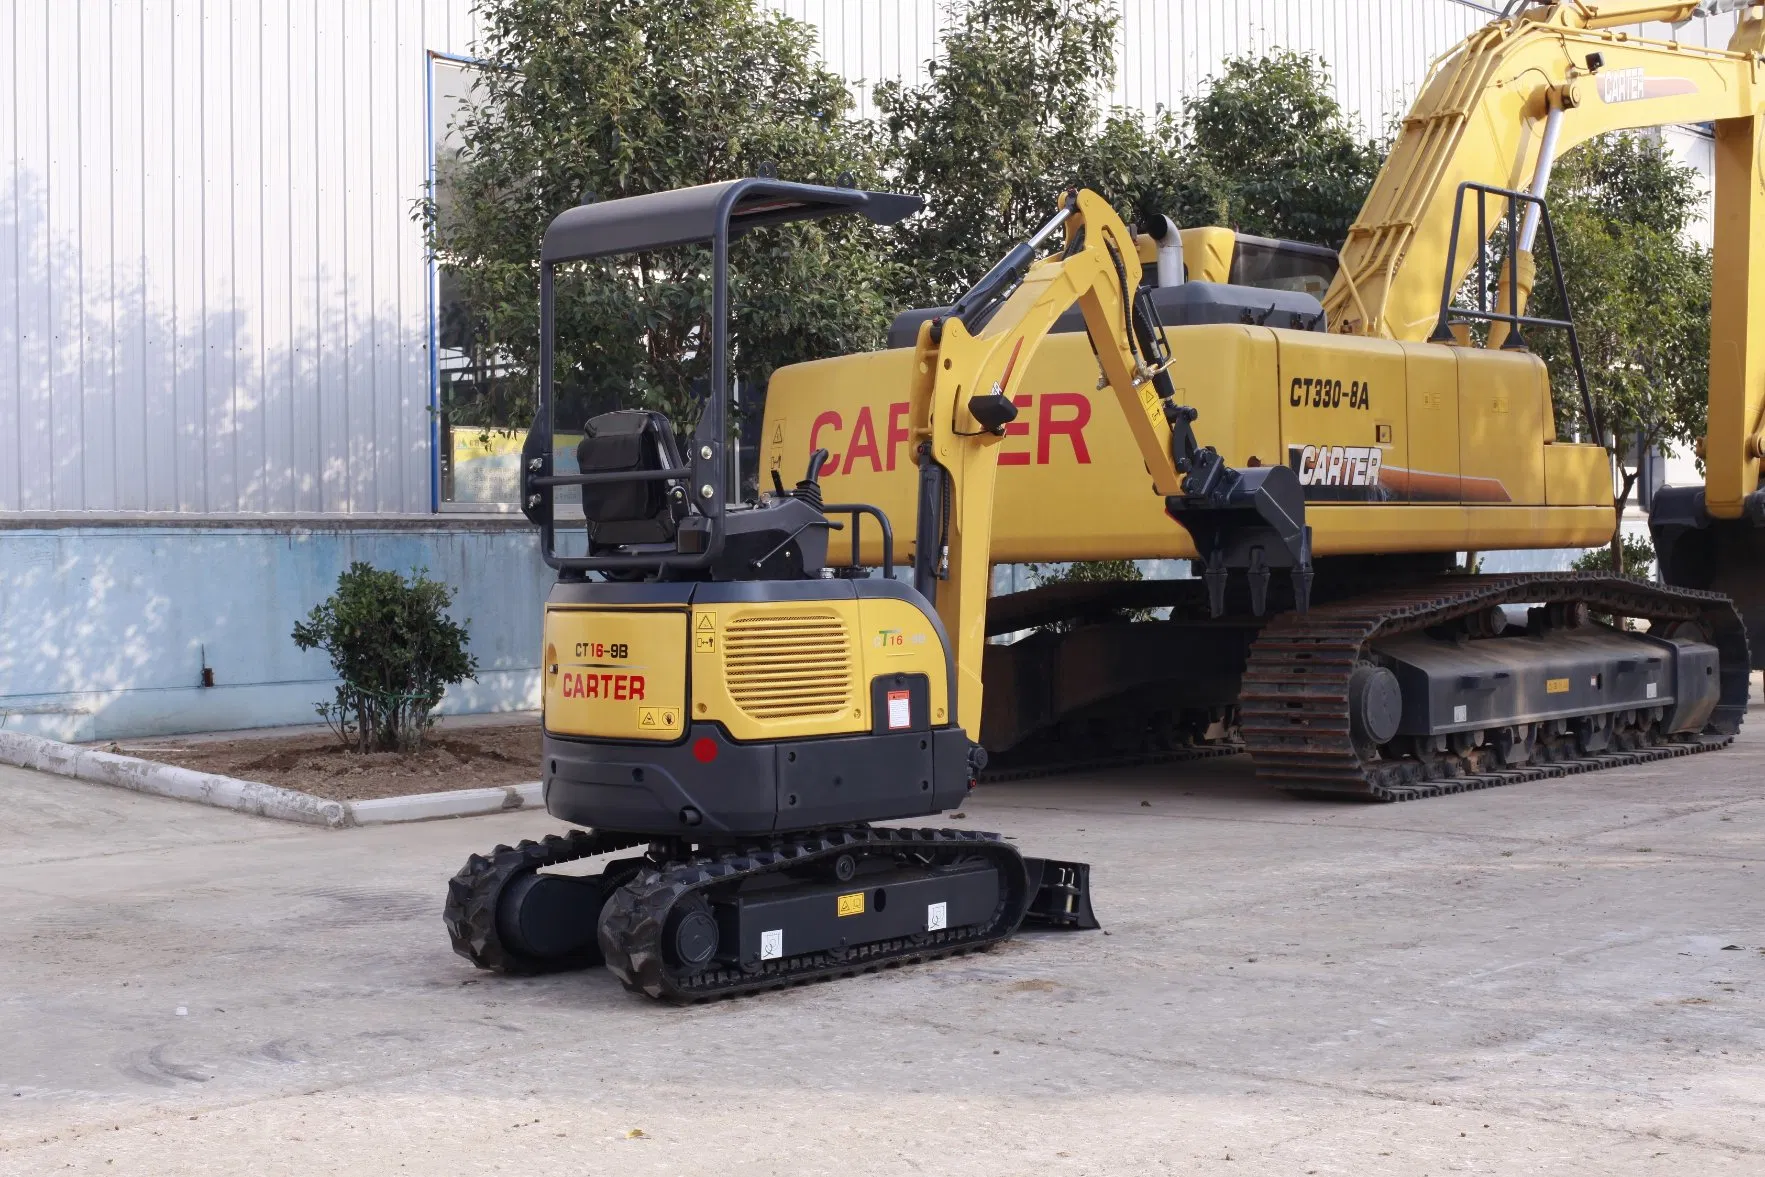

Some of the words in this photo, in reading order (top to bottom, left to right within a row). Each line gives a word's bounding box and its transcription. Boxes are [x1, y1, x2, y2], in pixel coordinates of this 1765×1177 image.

[1604, 68, 1644, 103] CARTER
[1290, 377, 1369, 410] CT330-8A
[809, 392, 1092, 477] CAER
[1298, 444, 1382, 486] CARTER
[575, 642, 628, 659] CT16-9B
[563, 672, 645, 700] CARTER
